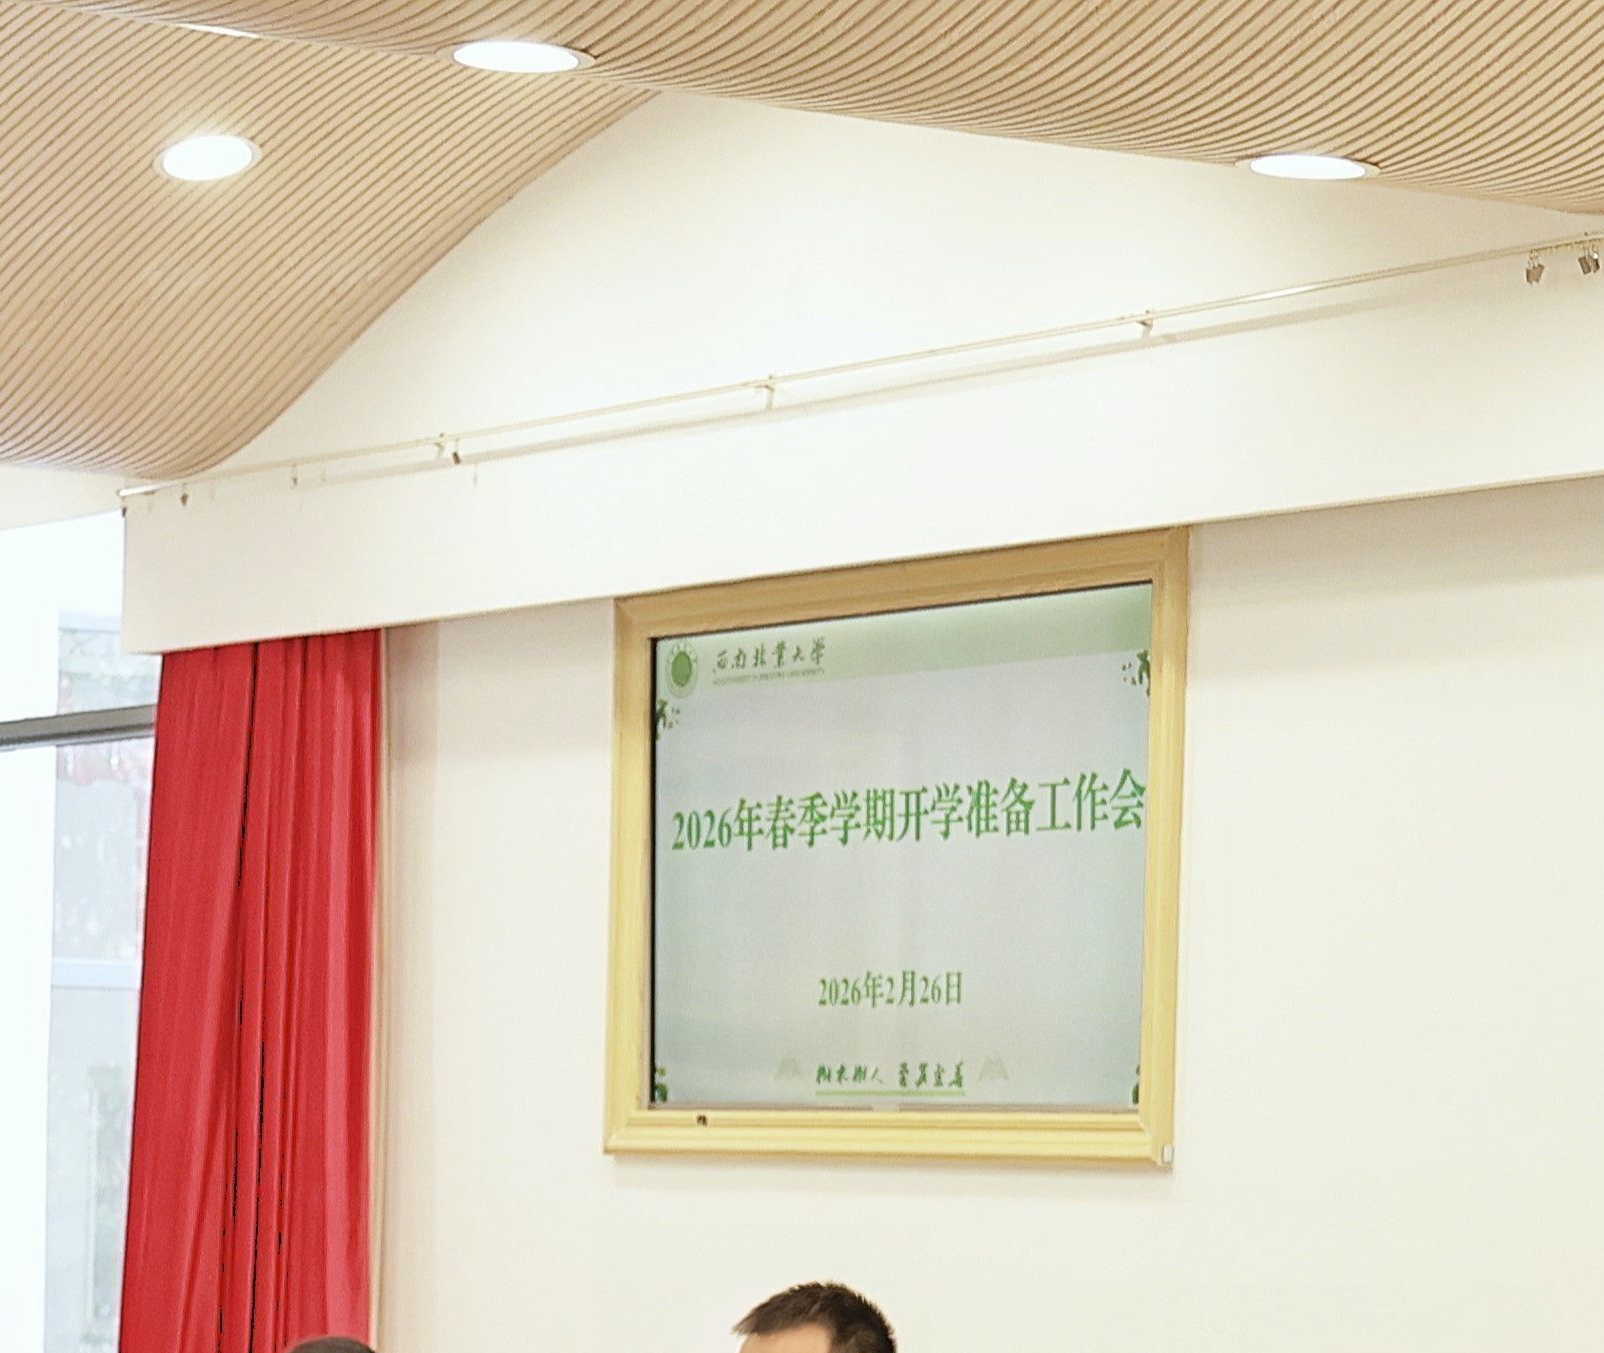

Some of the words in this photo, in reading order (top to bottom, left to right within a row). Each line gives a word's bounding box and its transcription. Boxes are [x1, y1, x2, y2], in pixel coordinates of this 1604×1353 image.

[672, 768, 1147, 852] 2026年春季学期开学准备工作会
[818, 970, 963, 1009] 2026年2月26日
